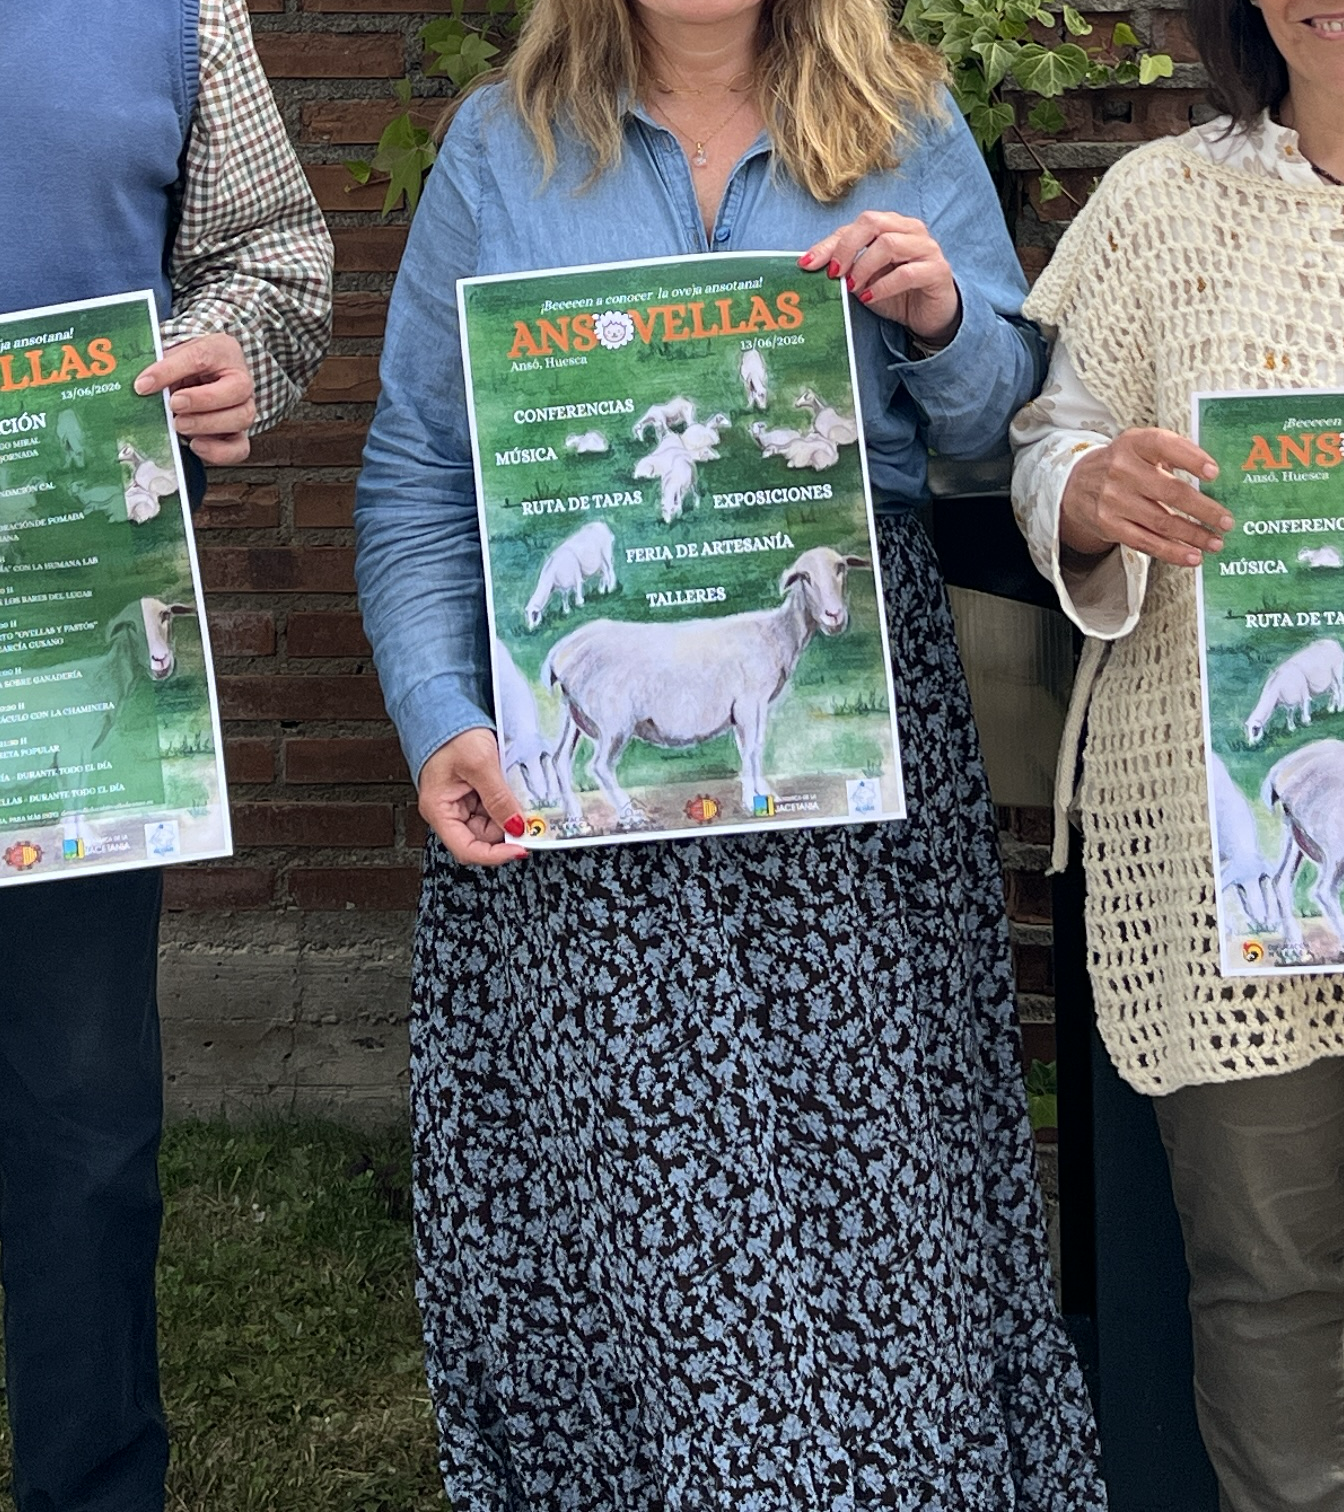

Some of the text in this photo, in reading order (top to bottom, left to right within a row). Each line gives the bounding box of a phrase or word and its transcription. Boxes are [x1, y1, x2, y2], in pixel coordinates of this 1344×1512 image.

[596, 298, 603, 306] a
[605, 292, 653, 305] conocer
[658, 287, 668, 299] la
[671, 284, 702, 297] oveja
[704, 277, 763, 294] ansotana!
[13, 327, 74, 349] ansotana!
[740, 334, 805, 350] 13/06/2026
[545, 356, 588, 368] Huesca
[61, 382, 121, 400] 13/06/2026
[513, 398, 634, 424] CONFERENCIAS
[495, 447, 558, 466] MÚSICA
[1282, 471, 1329, 482] Huesca
[521, 490, 643, 516] RUTA DE TAPAS
[712, 484, 833, 509] EXPOSICIONES
[626, 531, 795, 563] FERIA DE ARTESANÍA
[1219, 557, 1288, 576] MÚSICA
[646, 586, 726, 608] TALLERES
[1245, 613, 1293, 628] RUTA
[1296, 612, 1320, 626] DE
